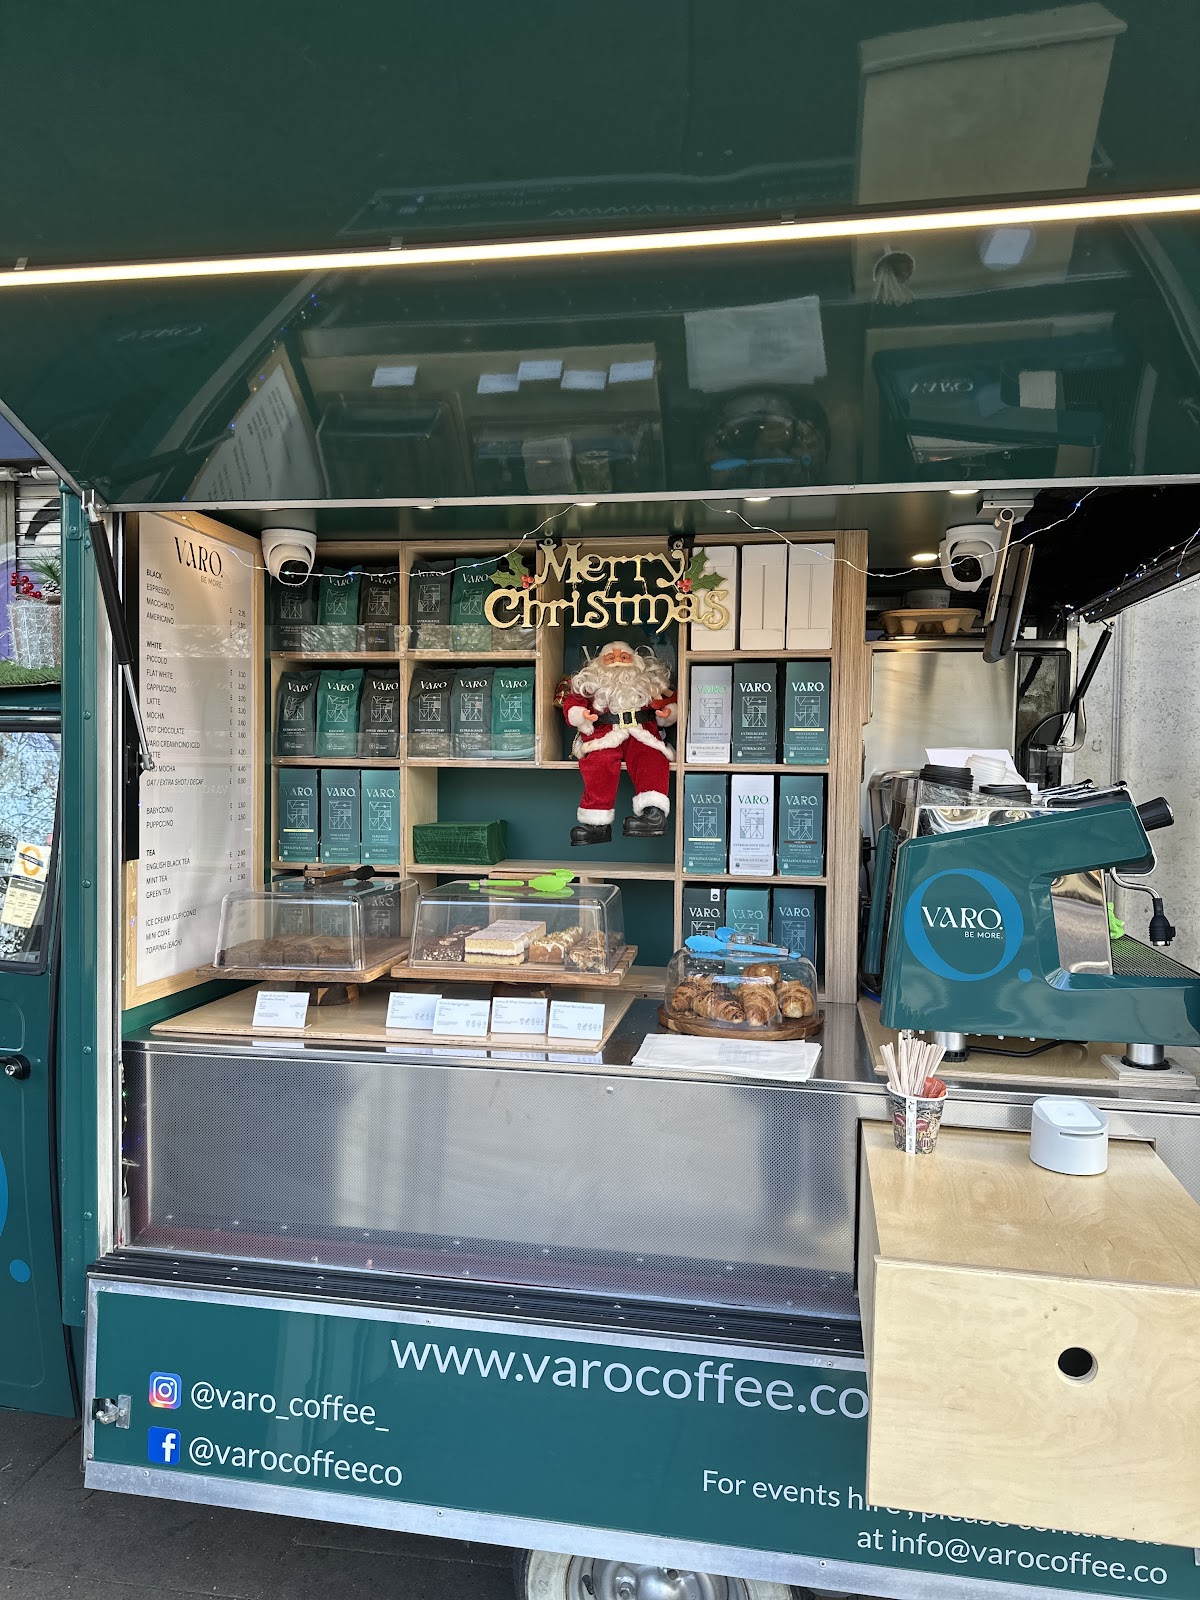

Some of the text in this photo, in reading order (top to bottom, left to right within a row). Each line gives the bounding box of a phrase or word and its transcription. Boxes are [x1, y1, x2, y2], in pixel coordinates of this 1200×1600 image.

[534, 542, 686, 587] Merry
[146, 569, 163, 580] BLACK
[146, 583, 171, 596] ESPRESSO
[146, 597, 175, 611] MACCHIATO
[484, 587, 730, 634] Christmas
[146, 612, 175, 625] AMERICANO
[146, 641, 162, 650] WHITE
[146, 655, 168, 665] PICCOLO
[146, 669, 158, 678] FLAT
[159, 671, 174, 680] WHITE
[146, 683, 177, 694] CAPPUCCINO
[739, 682, 772, 693] VARO.
[791, 681, 825, 692] VARO.
[146, 697, 161, 706] LATTE
[146, 711, 165, 720] MOCHA
[146, 725, 157, 733] HOT
[158, 726, 185, 735] CHOCOLATE
[158, 765, 176, 773] MOCHA
[146, 849, 156, 857] TEA
[146, 861, 167, 871] ENGLISH
[167, 859, 181, 868] BLACK
[182, 857, 191, 865] TEA
[146, 875, 158, 885] MINT
[159, 874, 168, 882] TEA
[146, 891, 162, 899] GREEN
[689, 907, 721, 918] VARO.
[146, 919, 154, 927] ICE
[155, 915, 171, 925] CREAM
[921, 906, 1004, 931] VARO.
[157, 928, 170, 938] CONE
[964, 931, 1004, 940] BE MORE.
[390, 1340, 869, 1419] www.varocoffee.co
[190, 1381, 390, 1432] @varo_coffee_
[189, 1436, 403, 1486] @varocoffeeco
[702, 1469, 841, 1507] For events
[857, 1529, 1168, 1585] at info@varocoffee.co
